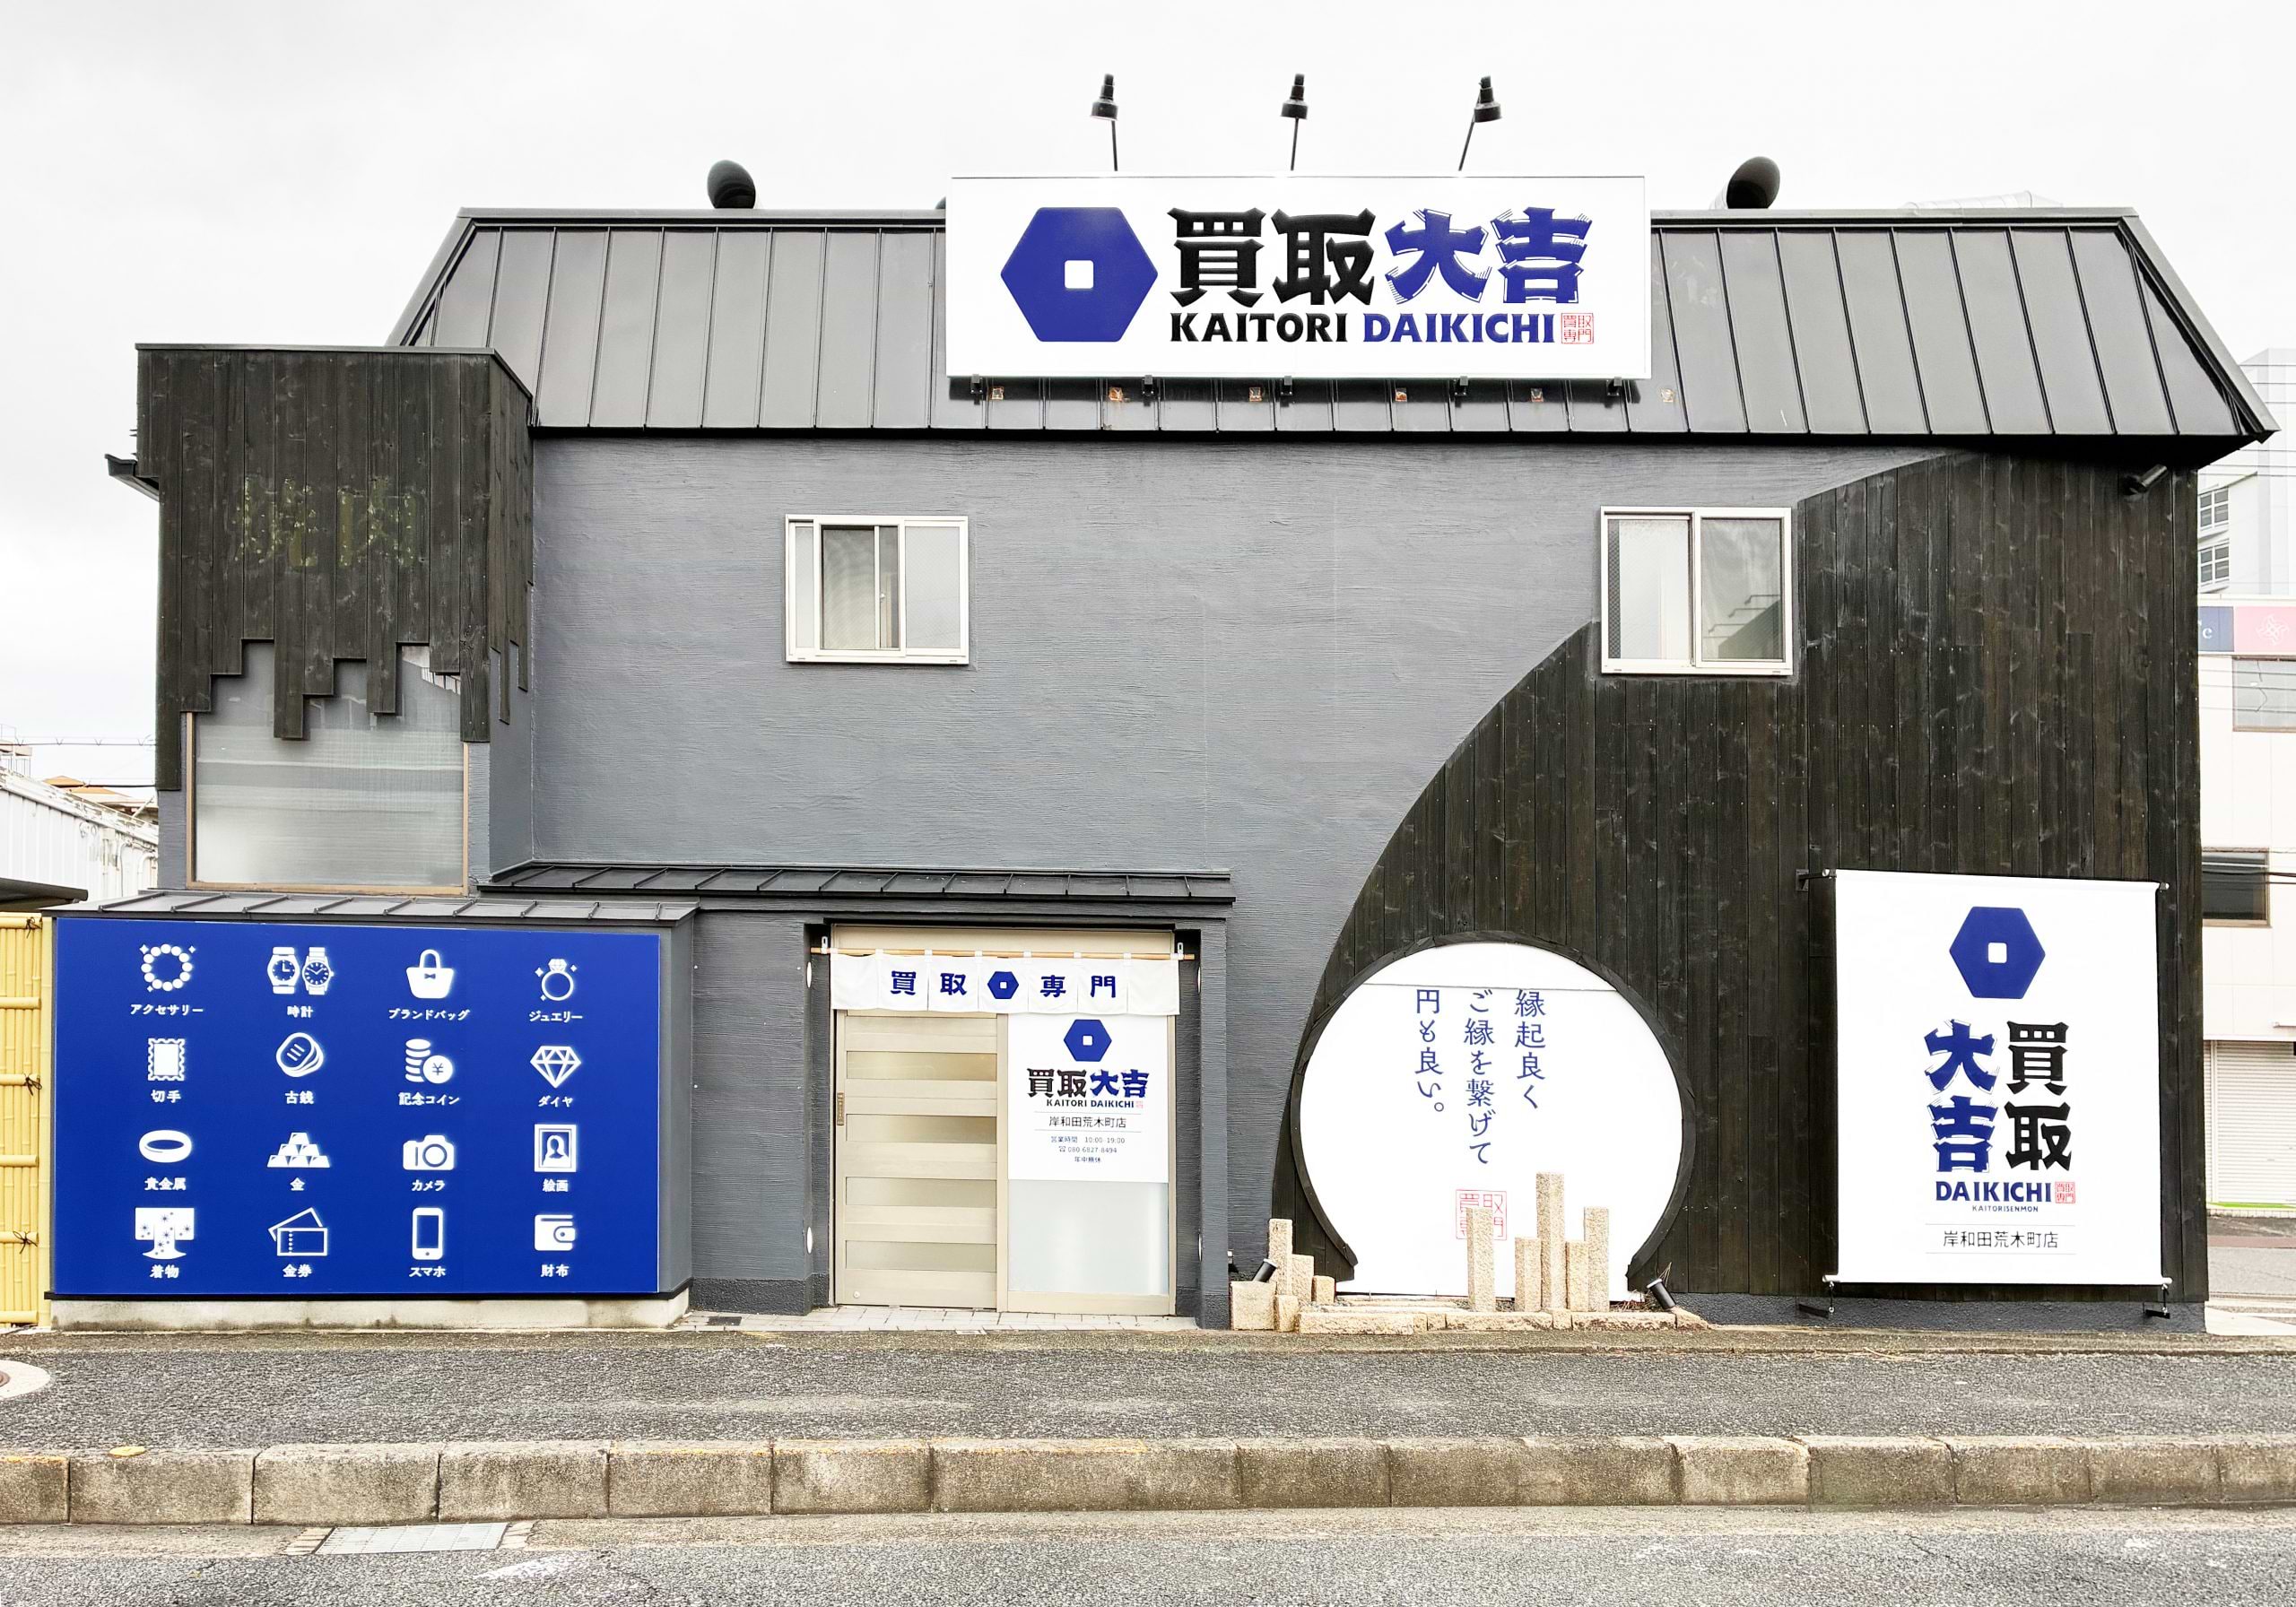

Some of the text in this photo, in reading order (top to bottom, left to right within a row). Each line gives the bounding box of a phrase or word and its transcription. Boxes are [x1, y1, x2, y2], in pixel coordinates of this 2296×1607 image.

[1168, 206, 1593, 306] 買取大吉
[1170, 312, 1555, 343] KAITORI DAIKICHI
[890, 970, 1117, 999] 買取 専門
[130, 1003, 204, 1016] アクセサリー
[286, 1004, 314, 1019] 時計
[388, 1007, 471, 1021] ブランドバッグ
[528, 1010, 583, 1023] ジュエリー
[1414, 989, 1445, 1112] 円も良い。
[1514, 989, 1546, 1109] 縁起良く
[1026, 1068, 1150, 1099] 買取大吉
[1463, 989, 1496, 1165] ご縁を繋げて
[150, 1089, 182, 1104] 切手
[284, 1090, 315, 1105] 古銭
[397, 1091, 460, 1106] 記念コイン
[538, 1095, 574, 1108] ダイヤ
[1046, 1099, 1087, 1108] KAITORI
[1090, 1099, 1135, 1108] DAIKICHI
[1923, 1019, 1999, 1173] 大吉
[2003, 1021, 2072, 1171] 買取
[1048, 1116, 1126, 1128] 岸和田荒木町店
[144, 1177, 187, 1191] 貴金属
[290, 1177, 306, 1192] 金
[411, 1179, 446, 1192] カメラ
[542, 1177, 569, 1193] 絵画
[1935, 1181, 2051, 1203] DAIKICHI
[1943, 1230, 2058, 1248] 岸和田荒木町店
[149, 1264, 179, 1279] 着物
[282, 1264, 312, 1278] 金券
[408, 1265, 447, 1278] スマホ
[540, 1264, 570, 1278] 財布
